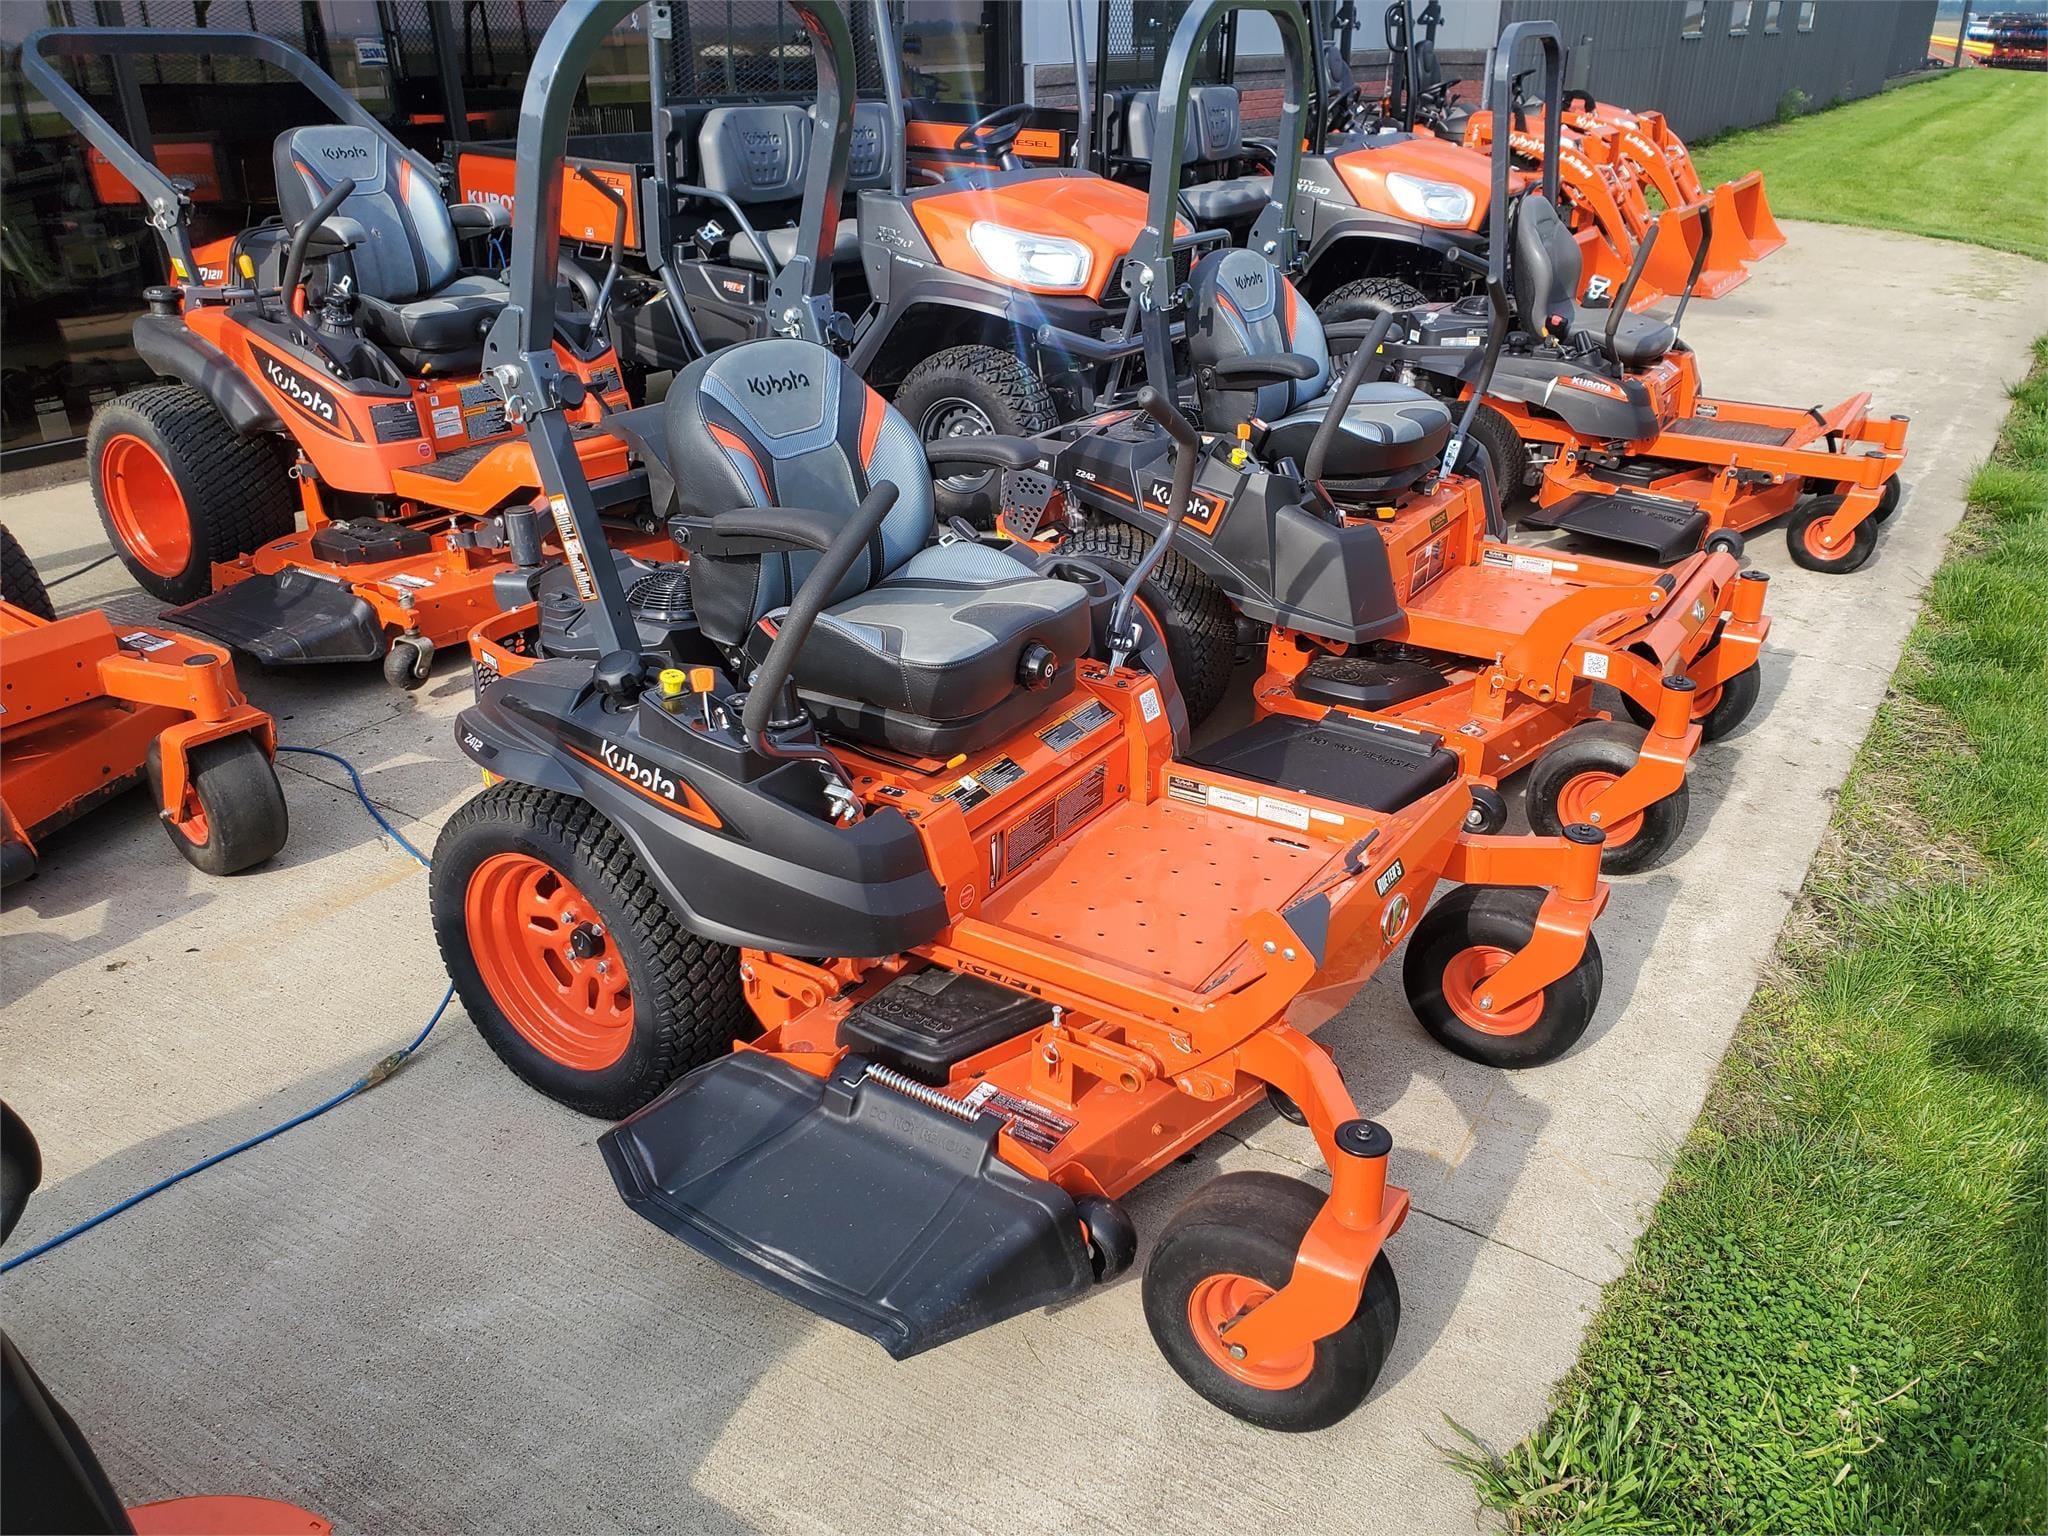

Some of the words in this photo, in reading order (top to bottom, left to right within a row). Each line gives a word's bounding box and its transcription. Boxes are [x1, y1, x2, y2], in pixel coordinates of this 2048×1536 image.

[321, 145, 367, 160] Kubota
[198, 266, 223, 281] D1211
[1234, 271, 1263, 290] Kubota
[267, 359, 333, 420] Kubota
[746, 369, 810, 397] Kubota
[1571, 376, 1612, 393] KUBOTA
[600, 738, 675, 801] Kubota
[876, 999, 904, 1014] NO
[901, 1005, 953, 1033] STEP
[894, 1114, 918, 1134] NOT
[920, 1126, 974, 1160] REMOVE
